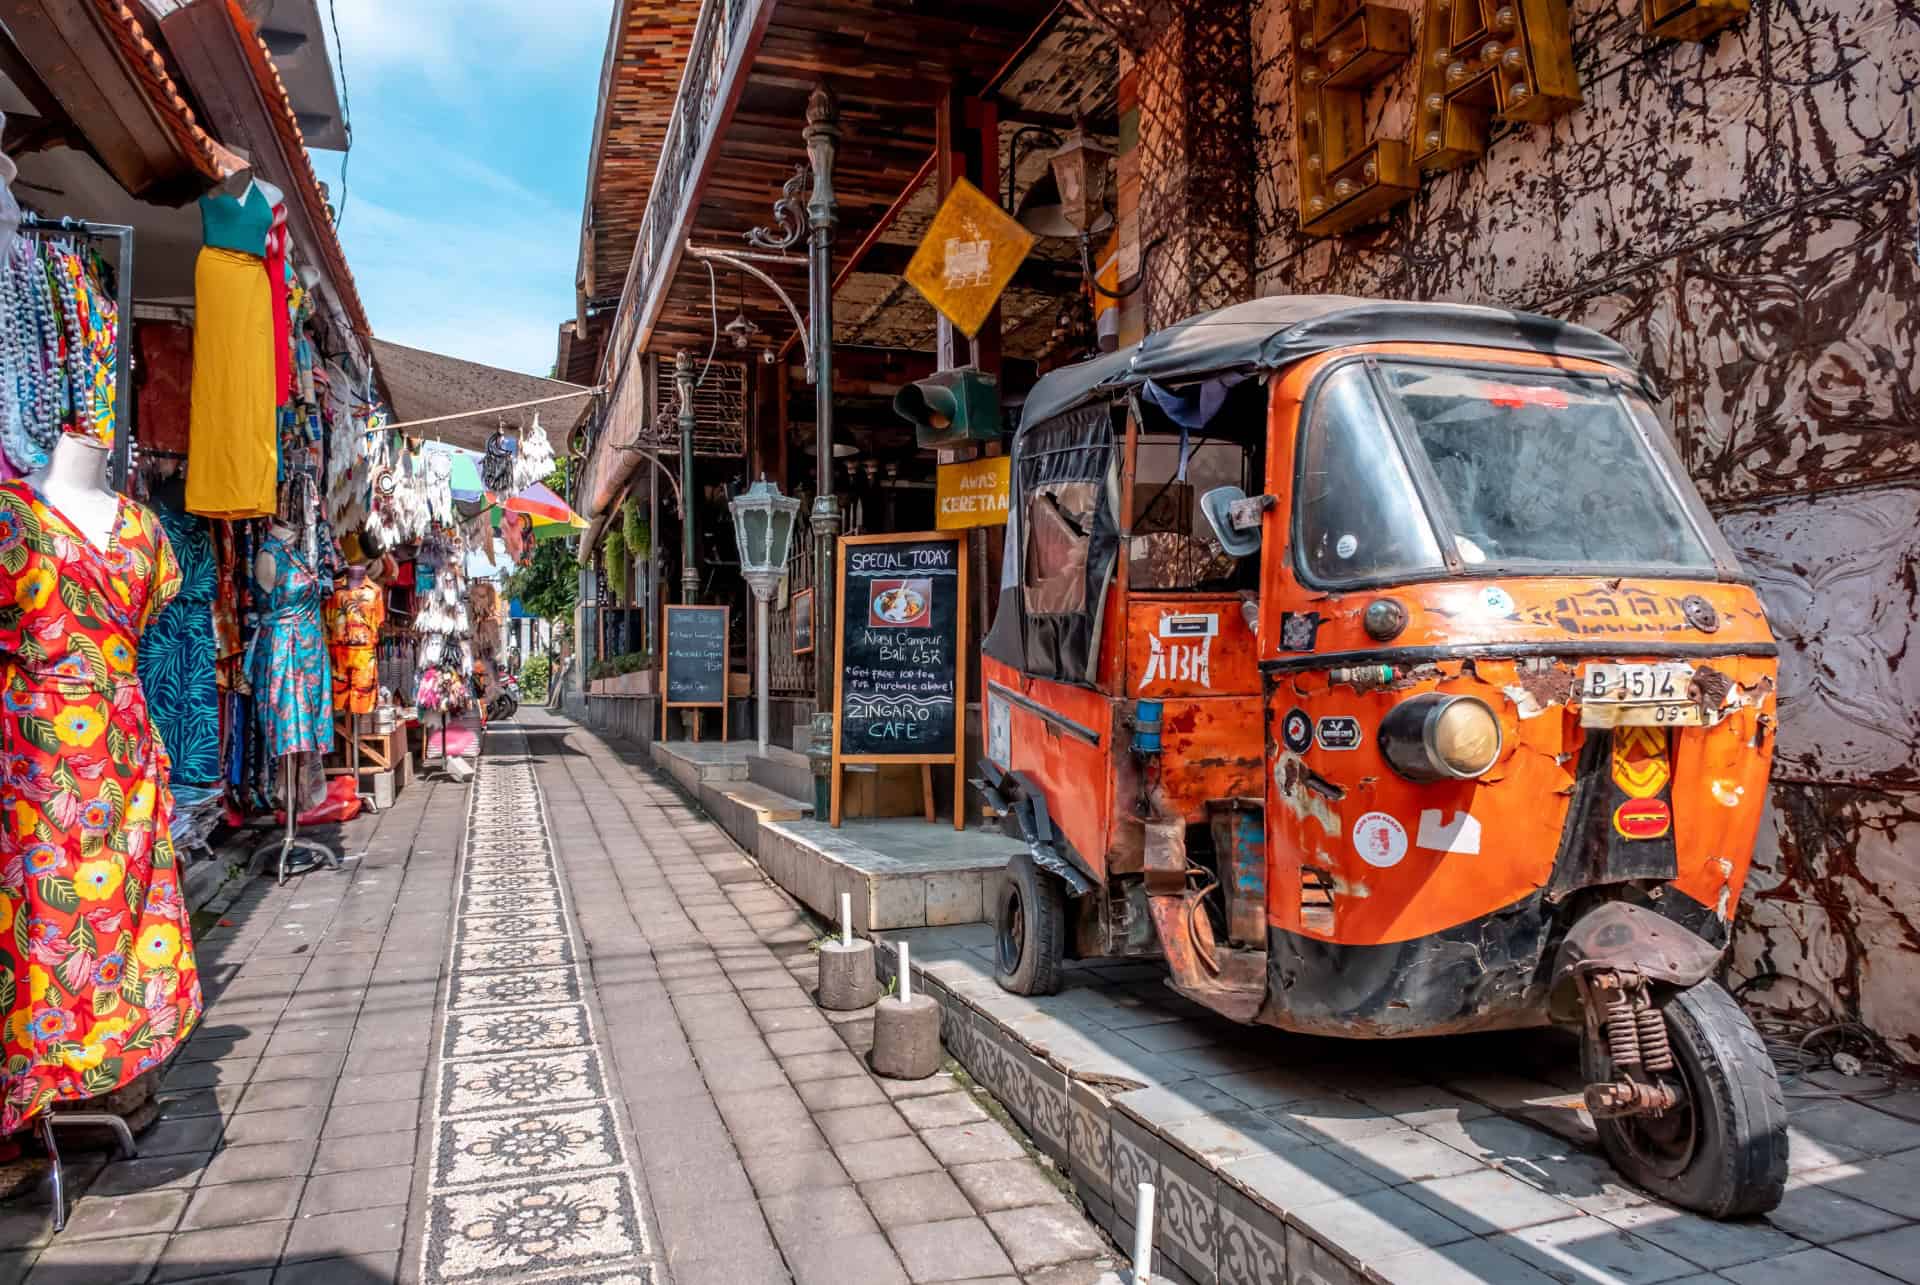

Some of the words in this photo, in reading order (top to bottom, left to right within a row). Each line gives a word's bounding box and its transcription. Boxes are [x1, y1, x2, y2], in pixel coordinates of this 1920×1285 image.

[851, 551, 907, 570] SPECIAL
[909, 548, 951, 567] TODAY
[896, 630, 942, 651] Campur
[1592, 671, 1606, 697] B
[1621, 671, 1675, 698] 1514
[847, 703, 930, 721] ZINGARO
[868, 720, 918, 739] CAFE
